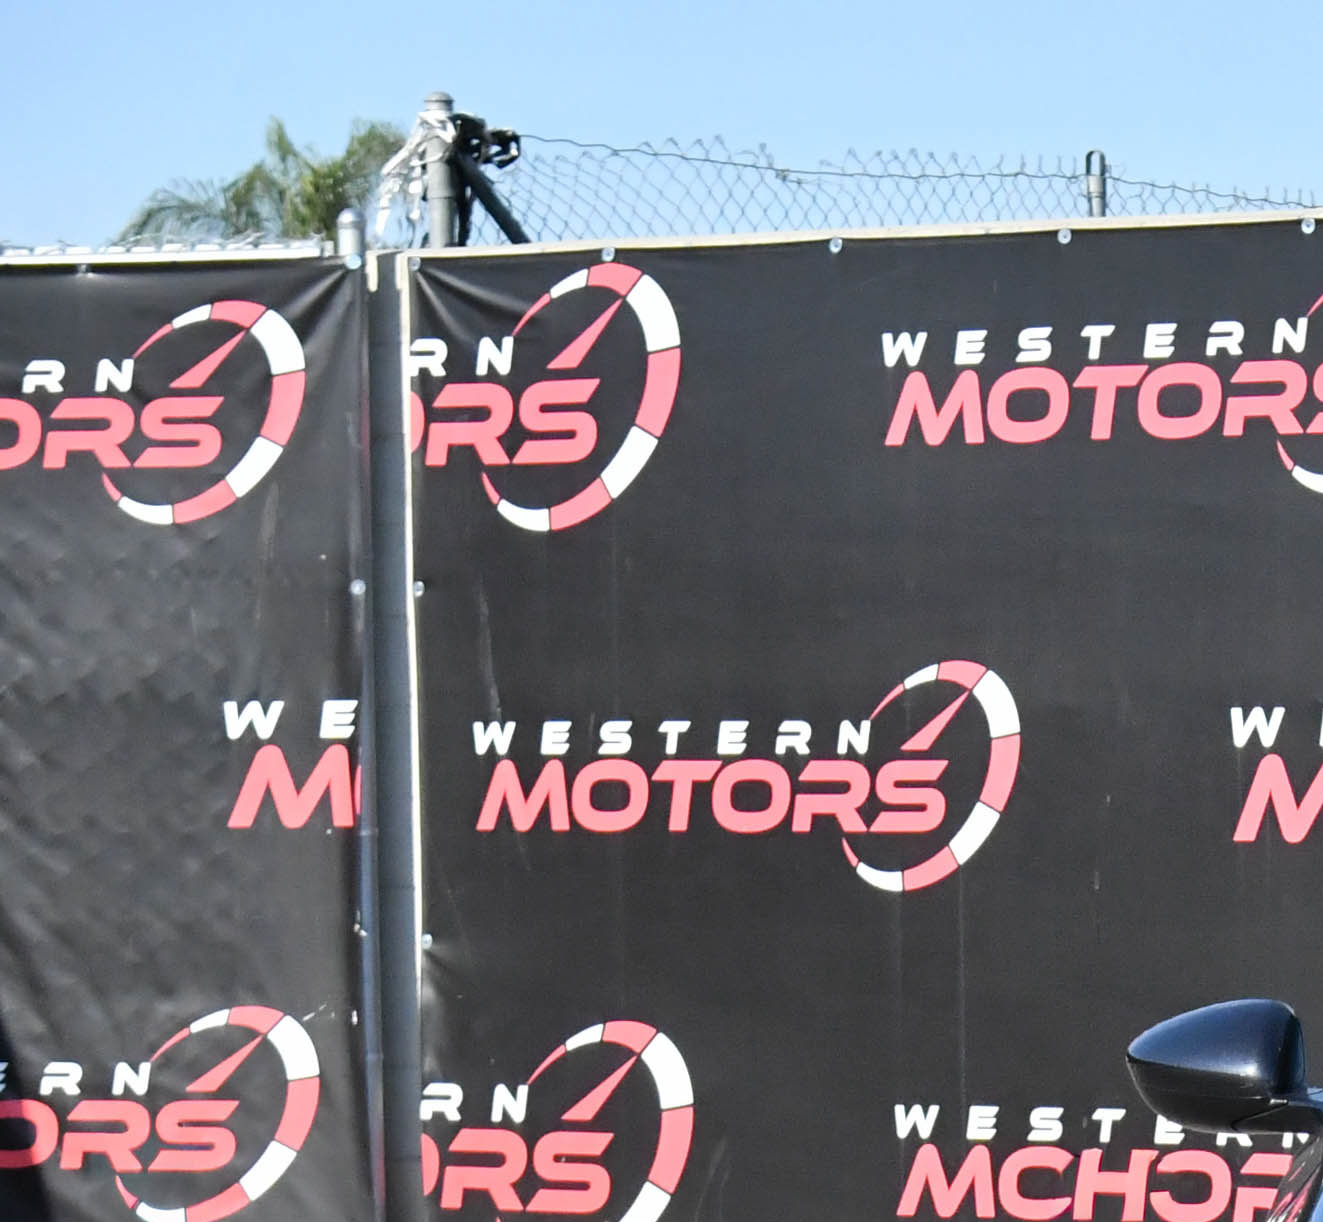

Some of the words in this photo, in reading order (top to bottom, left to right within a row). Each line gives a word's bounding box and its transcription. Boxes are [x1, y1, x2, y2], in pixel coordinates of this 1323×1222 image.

[881, 316, 1308, 367] WESTERN
[472, 719, 871, 755] WESTERN
[475, 757, 950, 834] MOTORS
